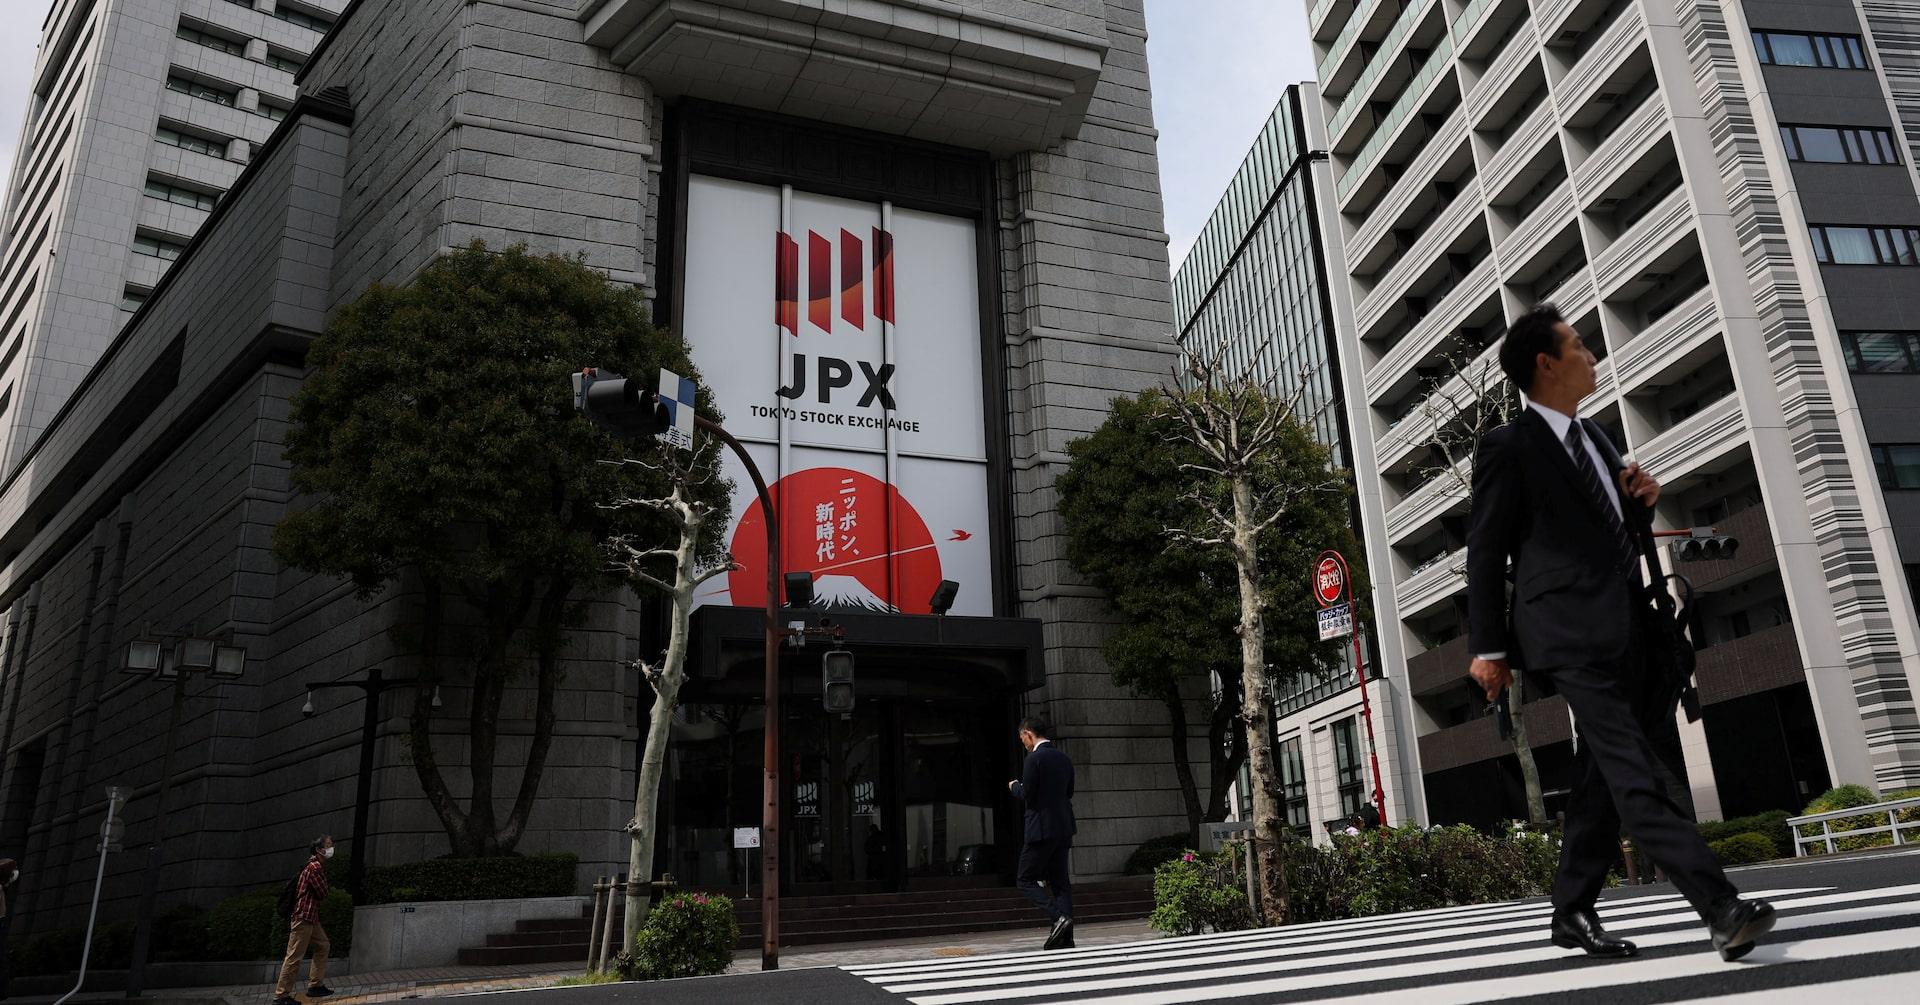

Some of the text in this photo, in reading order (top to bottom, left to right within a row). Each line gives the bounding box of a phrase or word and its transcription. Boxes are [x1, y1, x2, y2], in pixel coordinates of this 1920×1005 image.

[775, 353, 896, 410] JPX
[750, 405, 920, 433] TOKYO STOCK EXCHANGE
[664, 427, 692, 449] 差式
[816, 502, 835, 562] 新時代
[1319, 569, 1341, 591] 消火栓
[798, 805, 817, 815] JPX
[855, 804, 874, 814] JPX
